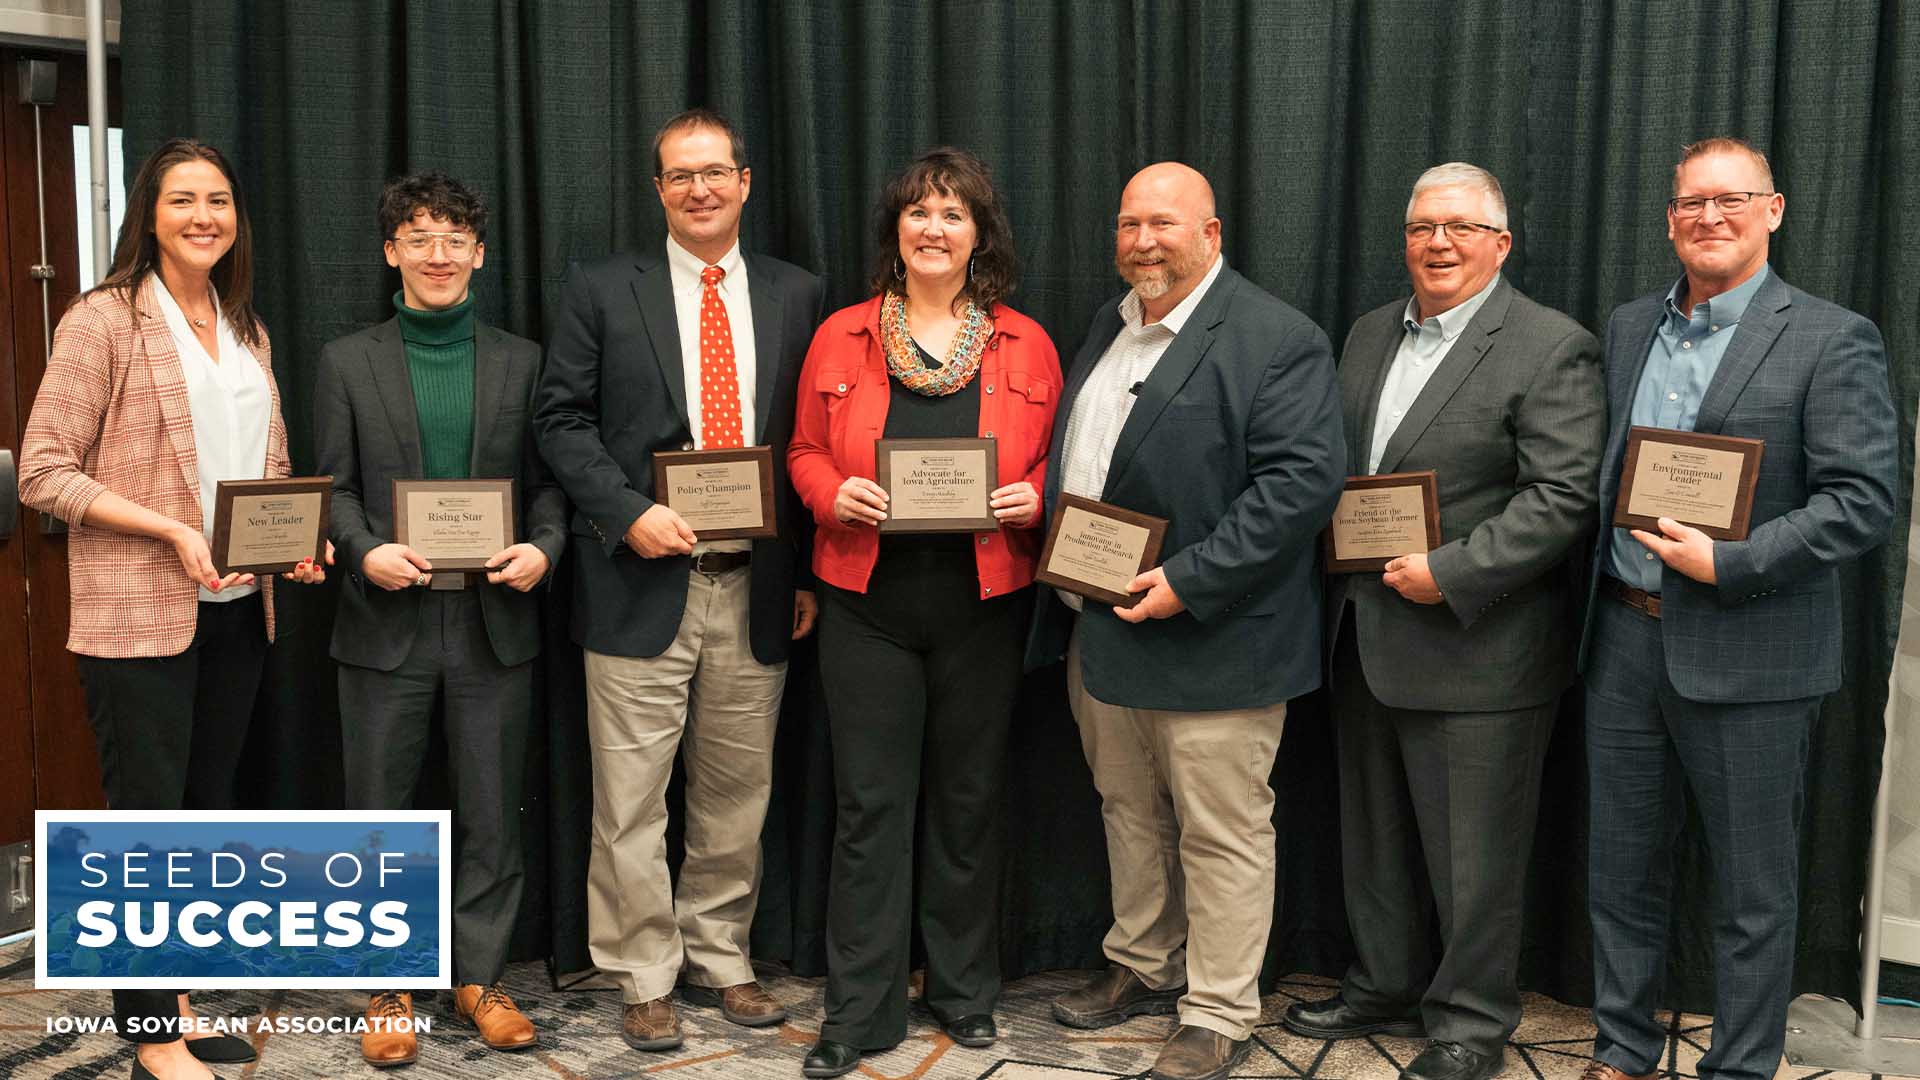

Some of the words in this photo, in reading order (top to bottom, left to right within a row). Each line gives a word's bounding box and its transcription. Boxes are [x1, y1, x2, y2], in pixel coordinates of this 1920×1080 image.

[911, 470, 951, 478] Advocate
[1652, 463, 1723, 481] Environmental
[903, 477, 924, 485] Iowa
[926, 477, 975, 486] Agriculture
[1669, 474, 1702, 486] Leader
[677, 486, 704, 495] Policy
[705, 483, 751, 494] Champion
[428, 512, 460, 522] Rising
[462, 512, 483, 521] Star
[1354, 510, 1378, 518] Friend
[1358, 516, 1389, 526] Soybean
[1391, 514, 1418, 522] Farmer
[247, 517, 269, 527] New
[271, 515, 304, 526] Leader
[1064, 533, 1101, 551] Production
[1102, 546, 1134, 560] Research
[1114, 541, 1122, 550] in
